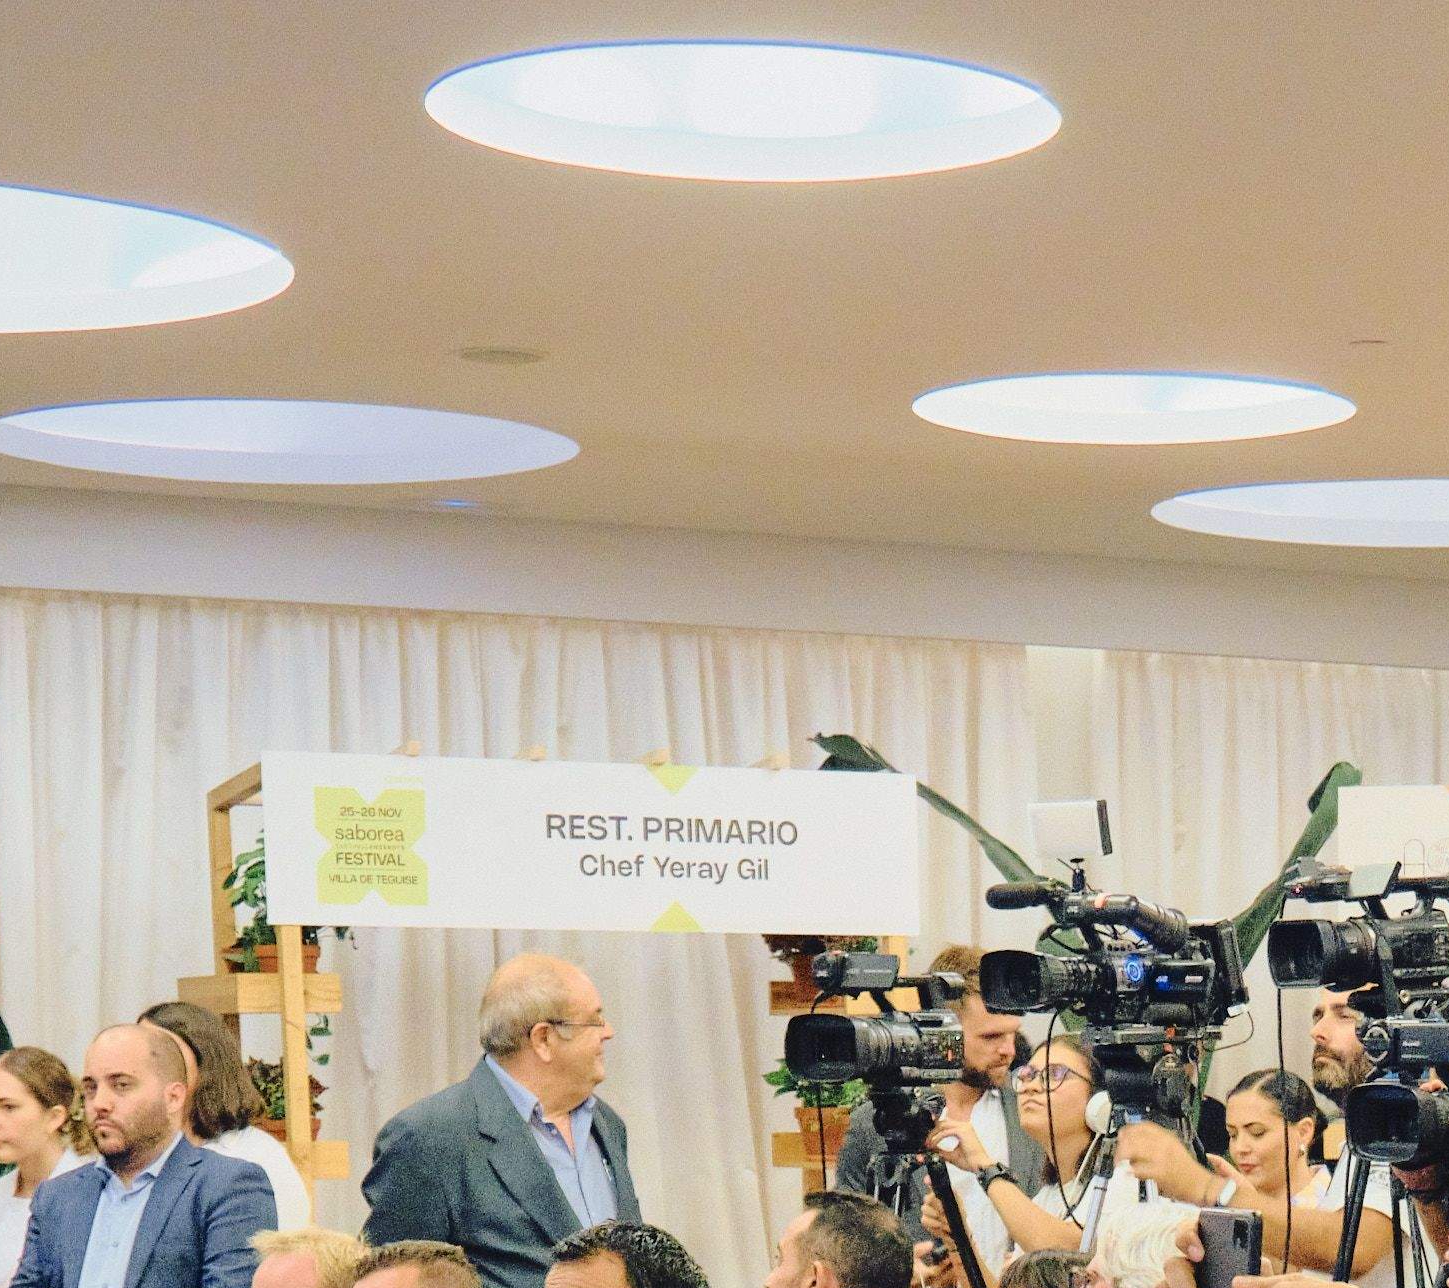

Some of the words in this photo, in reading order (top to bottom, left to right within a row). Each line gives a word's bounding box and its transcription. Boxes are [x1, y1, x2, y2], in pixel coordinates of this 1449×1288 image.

[378, 808, 402, 818] NOV
[335, 824, 404, 842] saborea
[545, 814, 633, 841] REST.
[643, 817, 798, 846] PRIMARIO
[336, 852, 405, 866] FESTIVAL
[579, 854, 644, 877] Chef
[653, 856, 728, 884] Yeray
[737, 858, 769, 880] Gil
[329, 874, 356, 884] VILLA
[360, 874, 373, 884] DE
